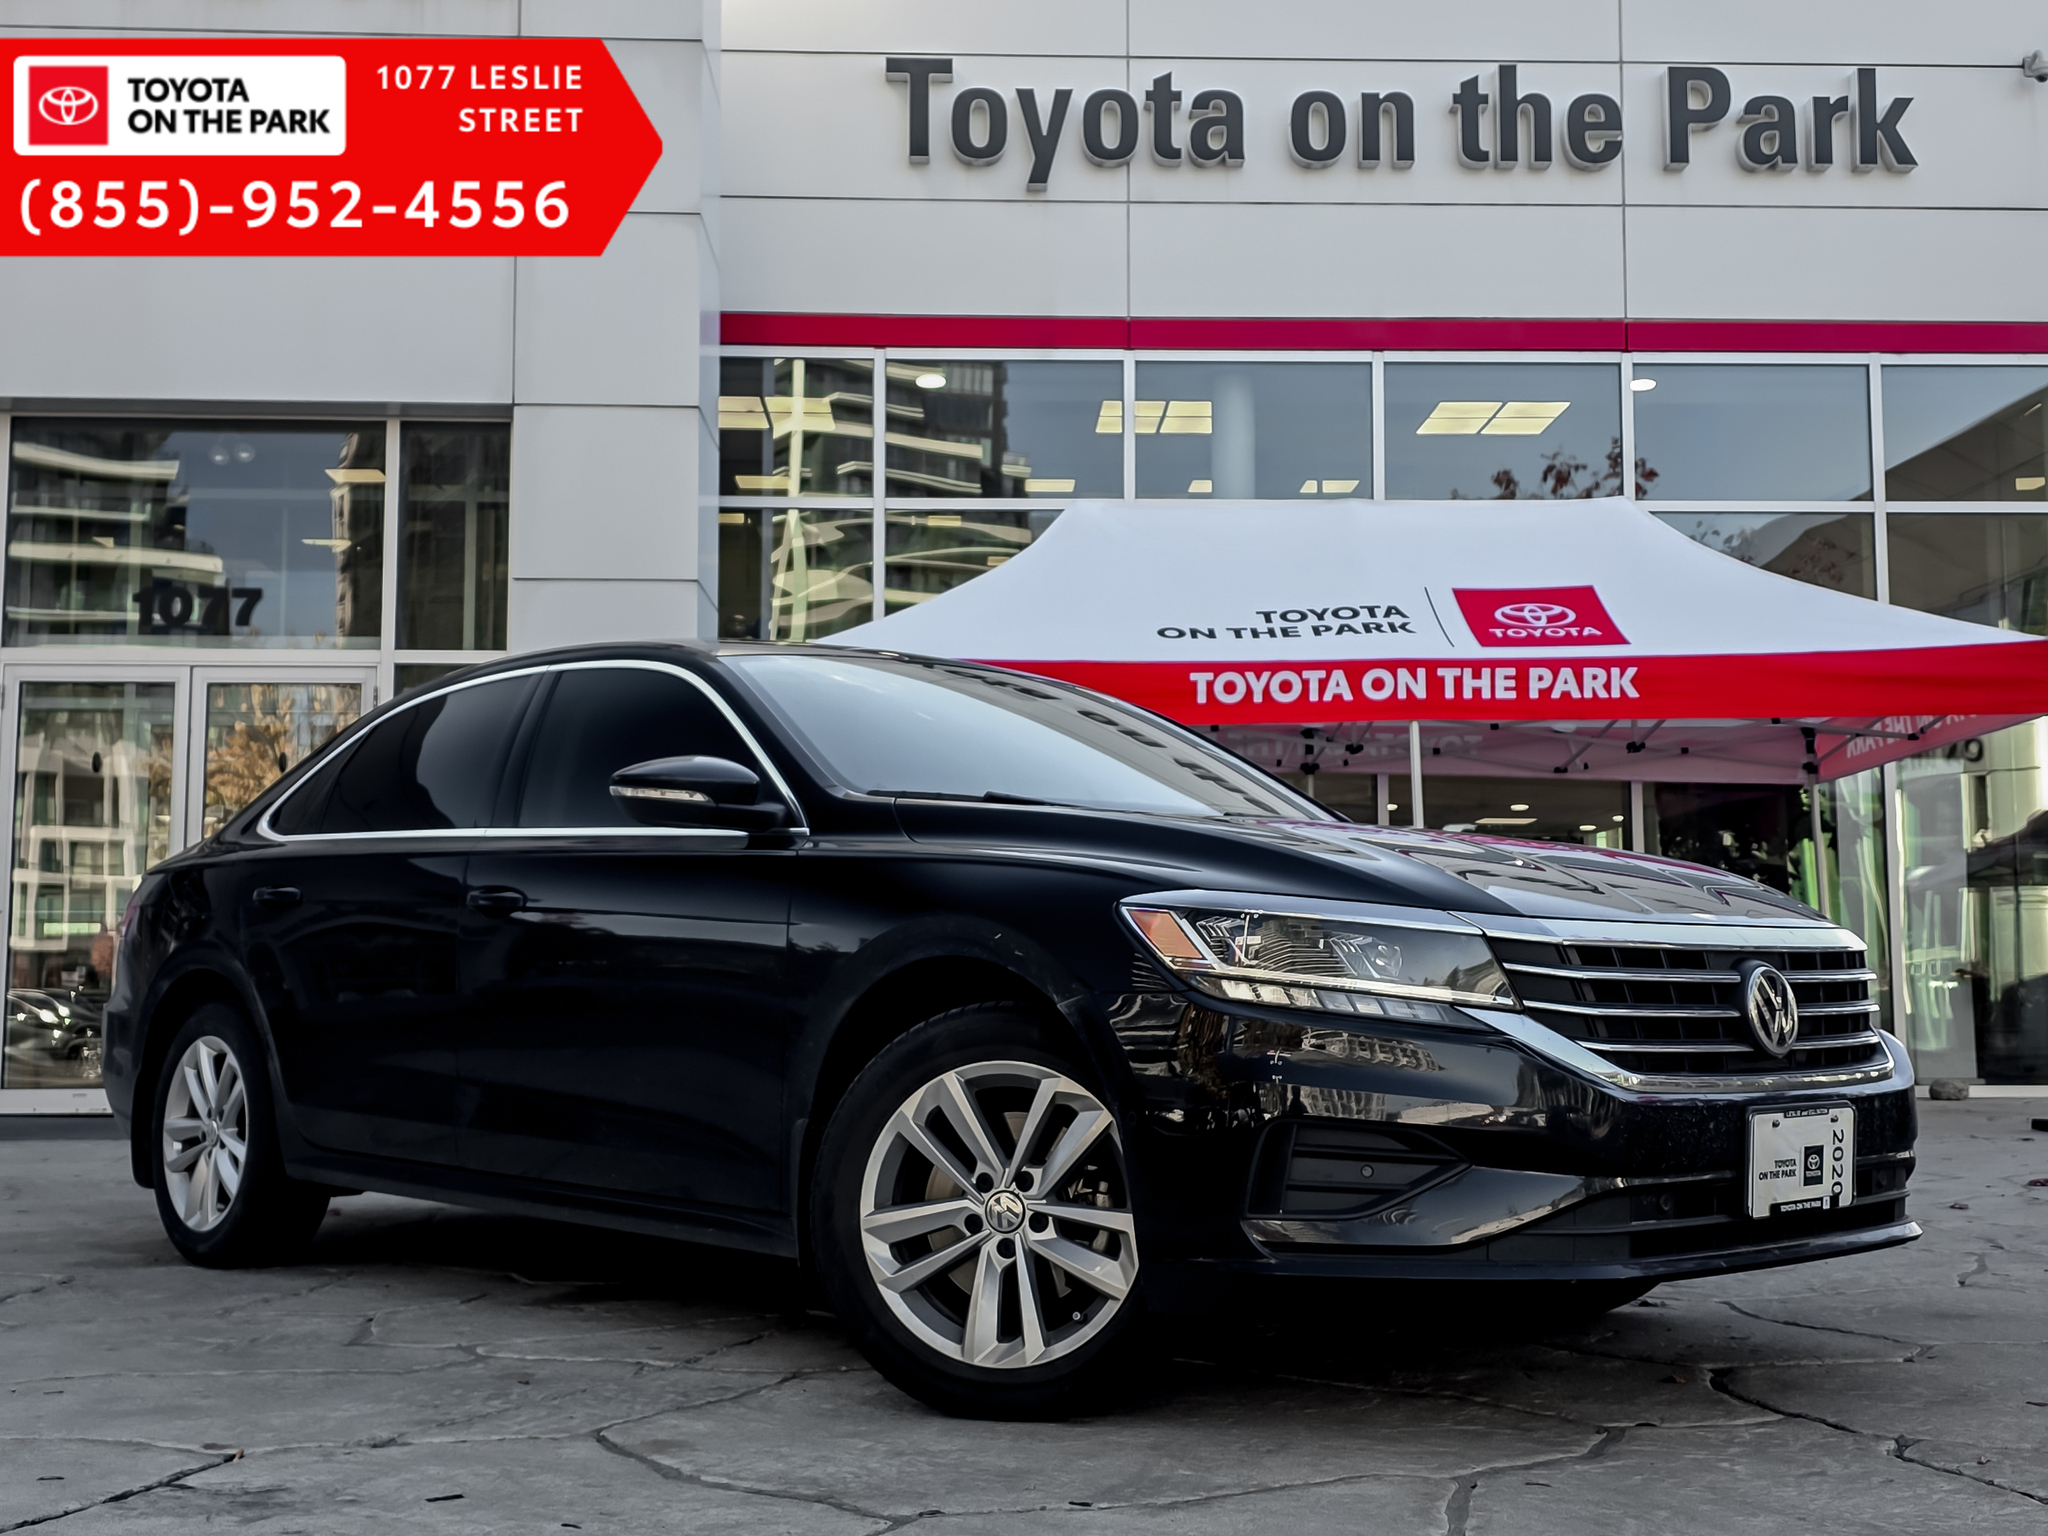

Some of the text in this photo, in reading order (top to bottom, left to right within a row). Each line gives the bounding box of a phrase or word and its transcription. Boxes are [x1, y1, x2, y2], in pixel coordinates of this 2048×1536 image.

[885, 55, 1919, 192] Toyota on the Park
[132, 586, 264, 627] 1077
[1256, 604, 1410, 624] TOYOTA
[1156, 620, 1418, 640] ON THE PARK
[1489, 625, 1603, 639] TOYOTA
[1189, 666, 1640, 704] TOYOTA ON THE PARK
[1774, 1158, 1797, 1169] TOYOTA
[1831, 1129, 1845, 1196] 2020
[1758, 1171, 1769, 1181] ON
[1769, 1170, 1780, 1180] THE
[1781, 1168, 1797, 1179] PARK
